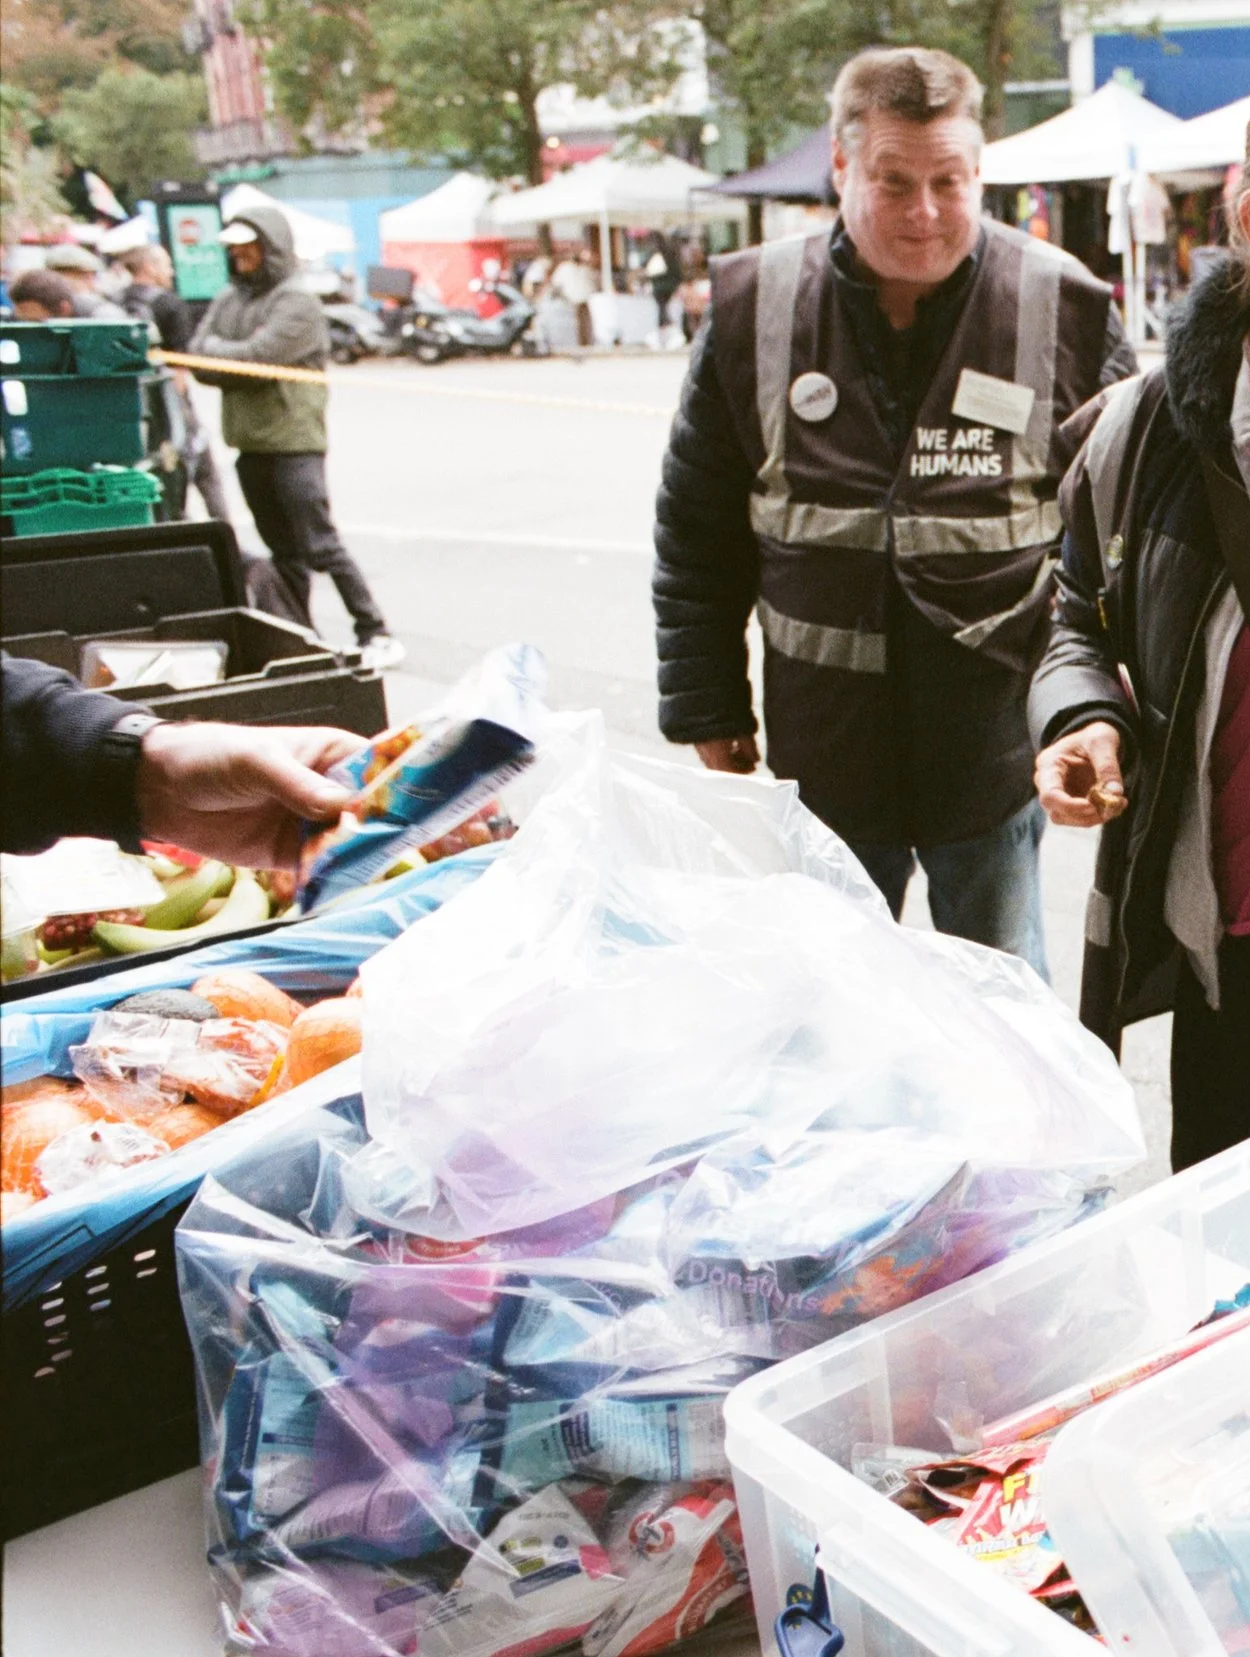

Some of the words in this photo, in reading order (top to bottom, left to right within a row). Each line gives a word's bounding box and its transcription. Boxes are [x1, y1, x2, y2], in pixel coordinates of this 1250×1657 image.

[916, 427, 948, 451] WE
[952, 428, 994, 452] ARE
[909, 454, 1003, 477] HUMANS
